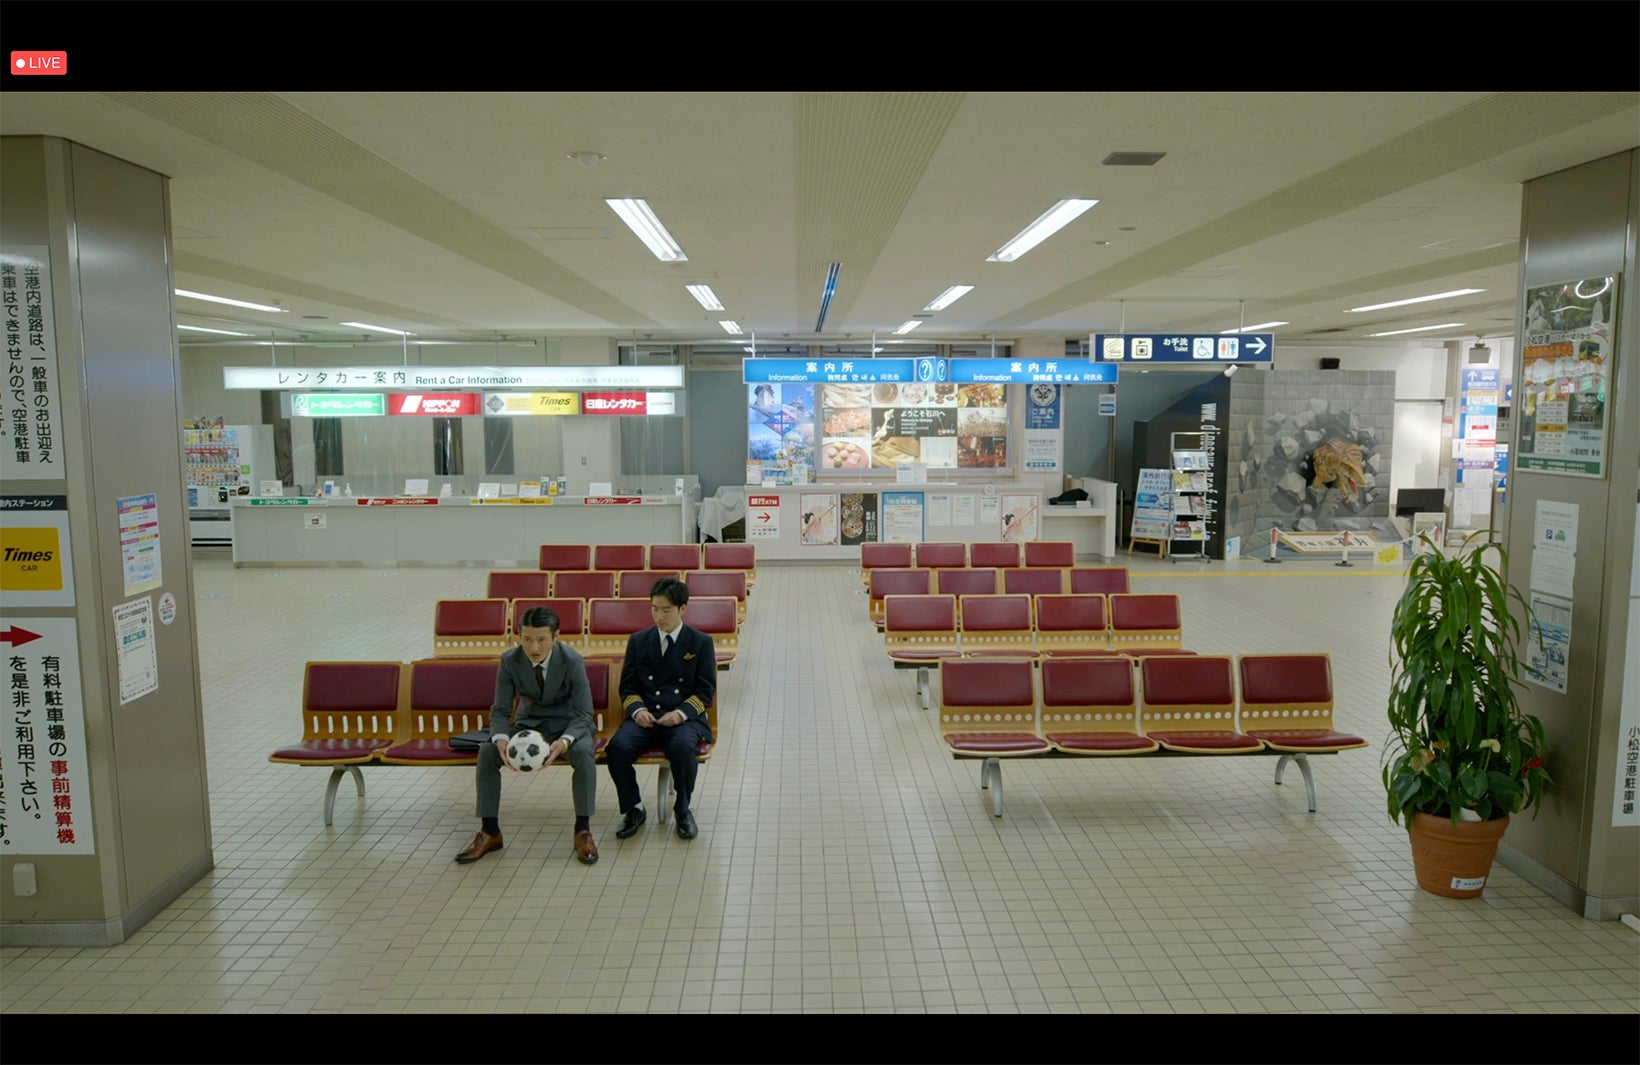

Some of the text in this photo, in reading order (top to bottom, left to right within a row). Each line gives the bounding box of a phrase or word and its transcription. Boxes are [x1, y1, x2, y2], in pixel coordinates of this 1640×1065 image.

[1162, 337, 1189, 346] お手洗
[805, 361, 854, 373] 案内所
[1010, 362, 1058, 373] 案内所
[278, 371, 406, 385] レンタカー案内
[415, 376, 438, 385] Rent
[448, 376, 465, 385] Car
[467, 375, 522, 385] Information
[768, 374, 808, 382] Information
[973, 373, 1012, 382] Information
[422, 399, 461, 409] NIPPON
[539, 395, 571, 406] Times
[585, 398, 643, 410] 日産レンタカー
[900, 409, 946, 418] ようこそ石川へ
[4, 547, 54, 562] Times
[9, 655, 42, 820] を是非ご利用下さい。
